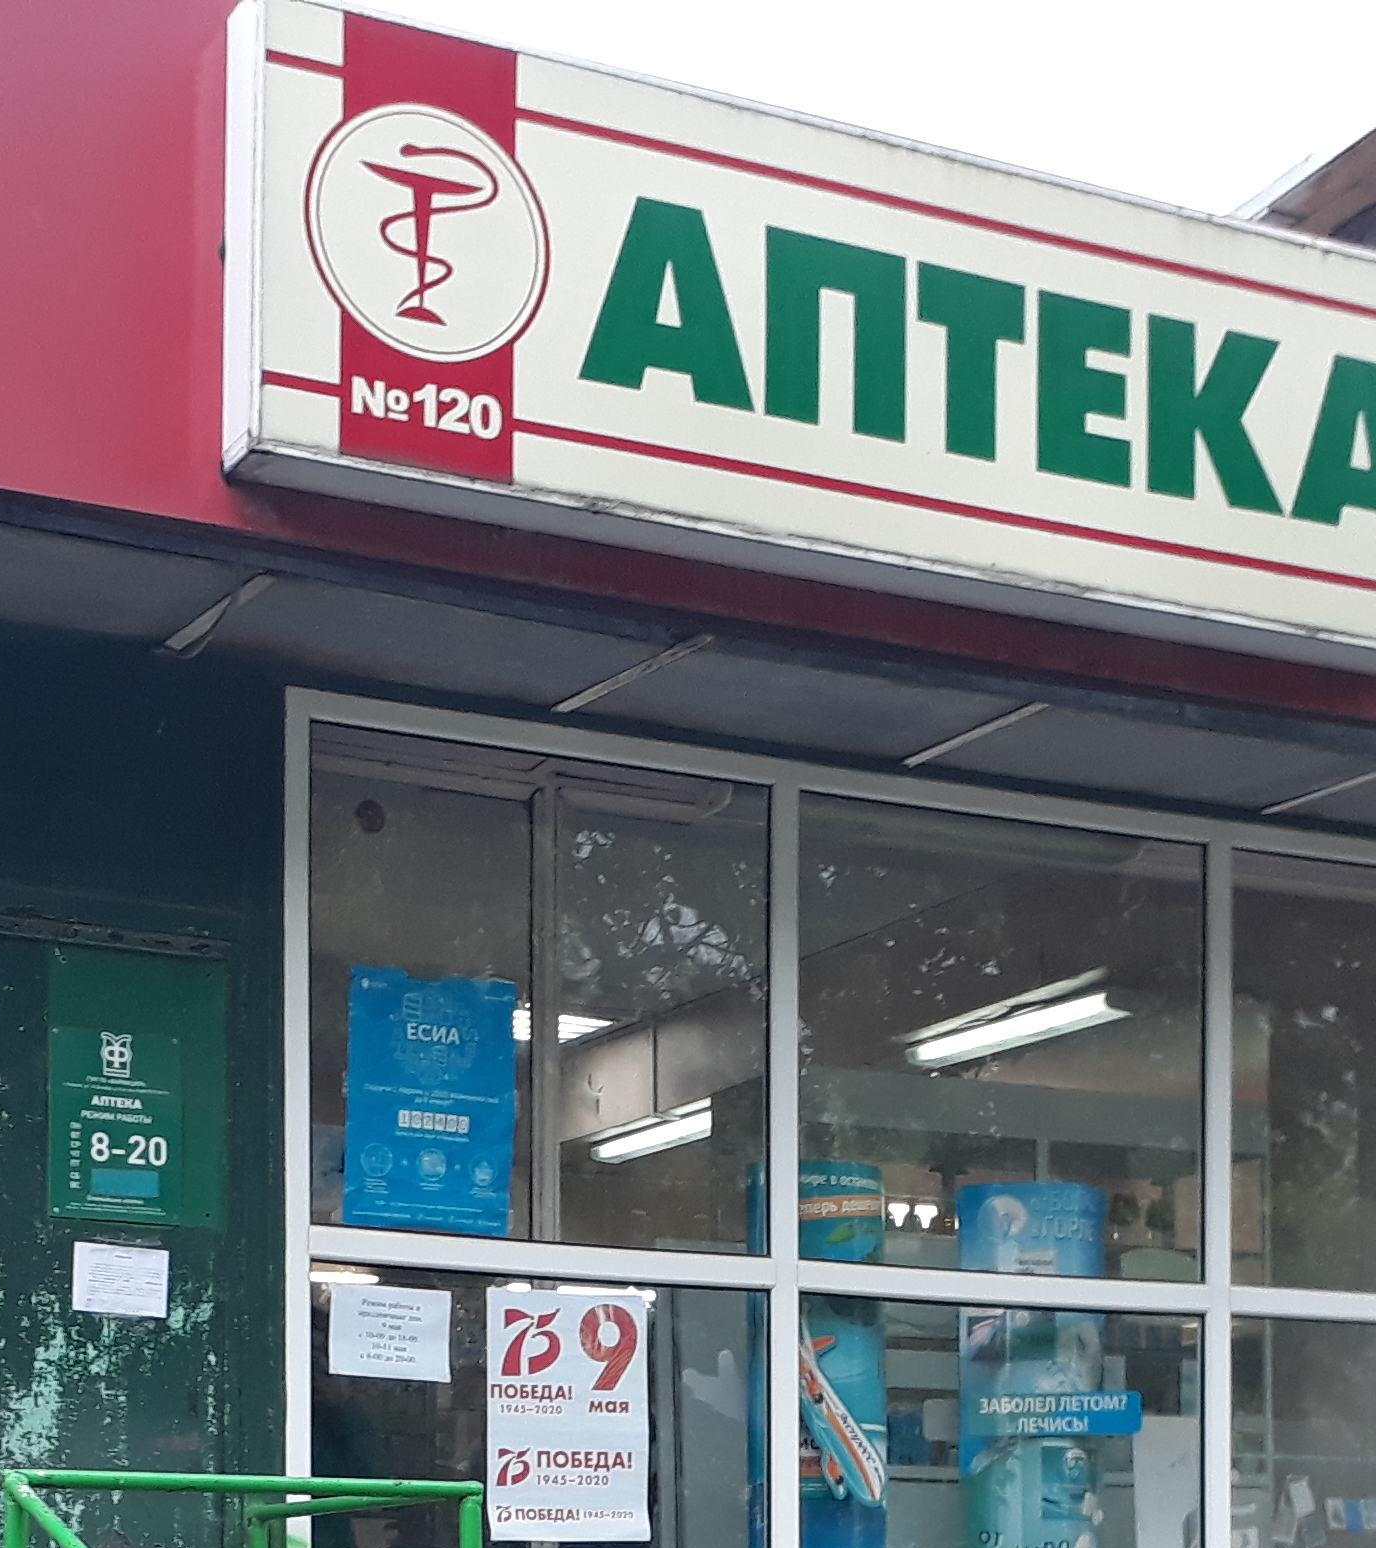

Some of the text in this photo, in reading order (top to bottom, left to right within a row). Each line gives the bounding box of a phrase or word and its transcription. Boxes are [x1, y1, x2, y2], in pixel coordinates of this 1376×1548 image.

[351, 375, 503, 440] №120
[407, 1023, 460, 1045] ЕСИА
[91, 1095, 142, 1109] АПТЕКА
[81, 1110, 153, 1124] РЕЖИМ РАБОТЫ
[90, 1131, 168, 1166] 8-20
[580, 1304, 638, 1391] 9
[490, 1384, 573, 1403] ПОБЕДА!
[588, 1400, 630, 1414] мая
[979, 1394, 1128, 1415] ЗАБОЛЕЛ ЛЕТОМ?
[1017, 1416, 1089, 1433] ЛЕЧИСЬ!
[536, 1450, 633, 1472] ПОБЕДА!
[515, 1508, 580, 1523] ПОБЕДА!
